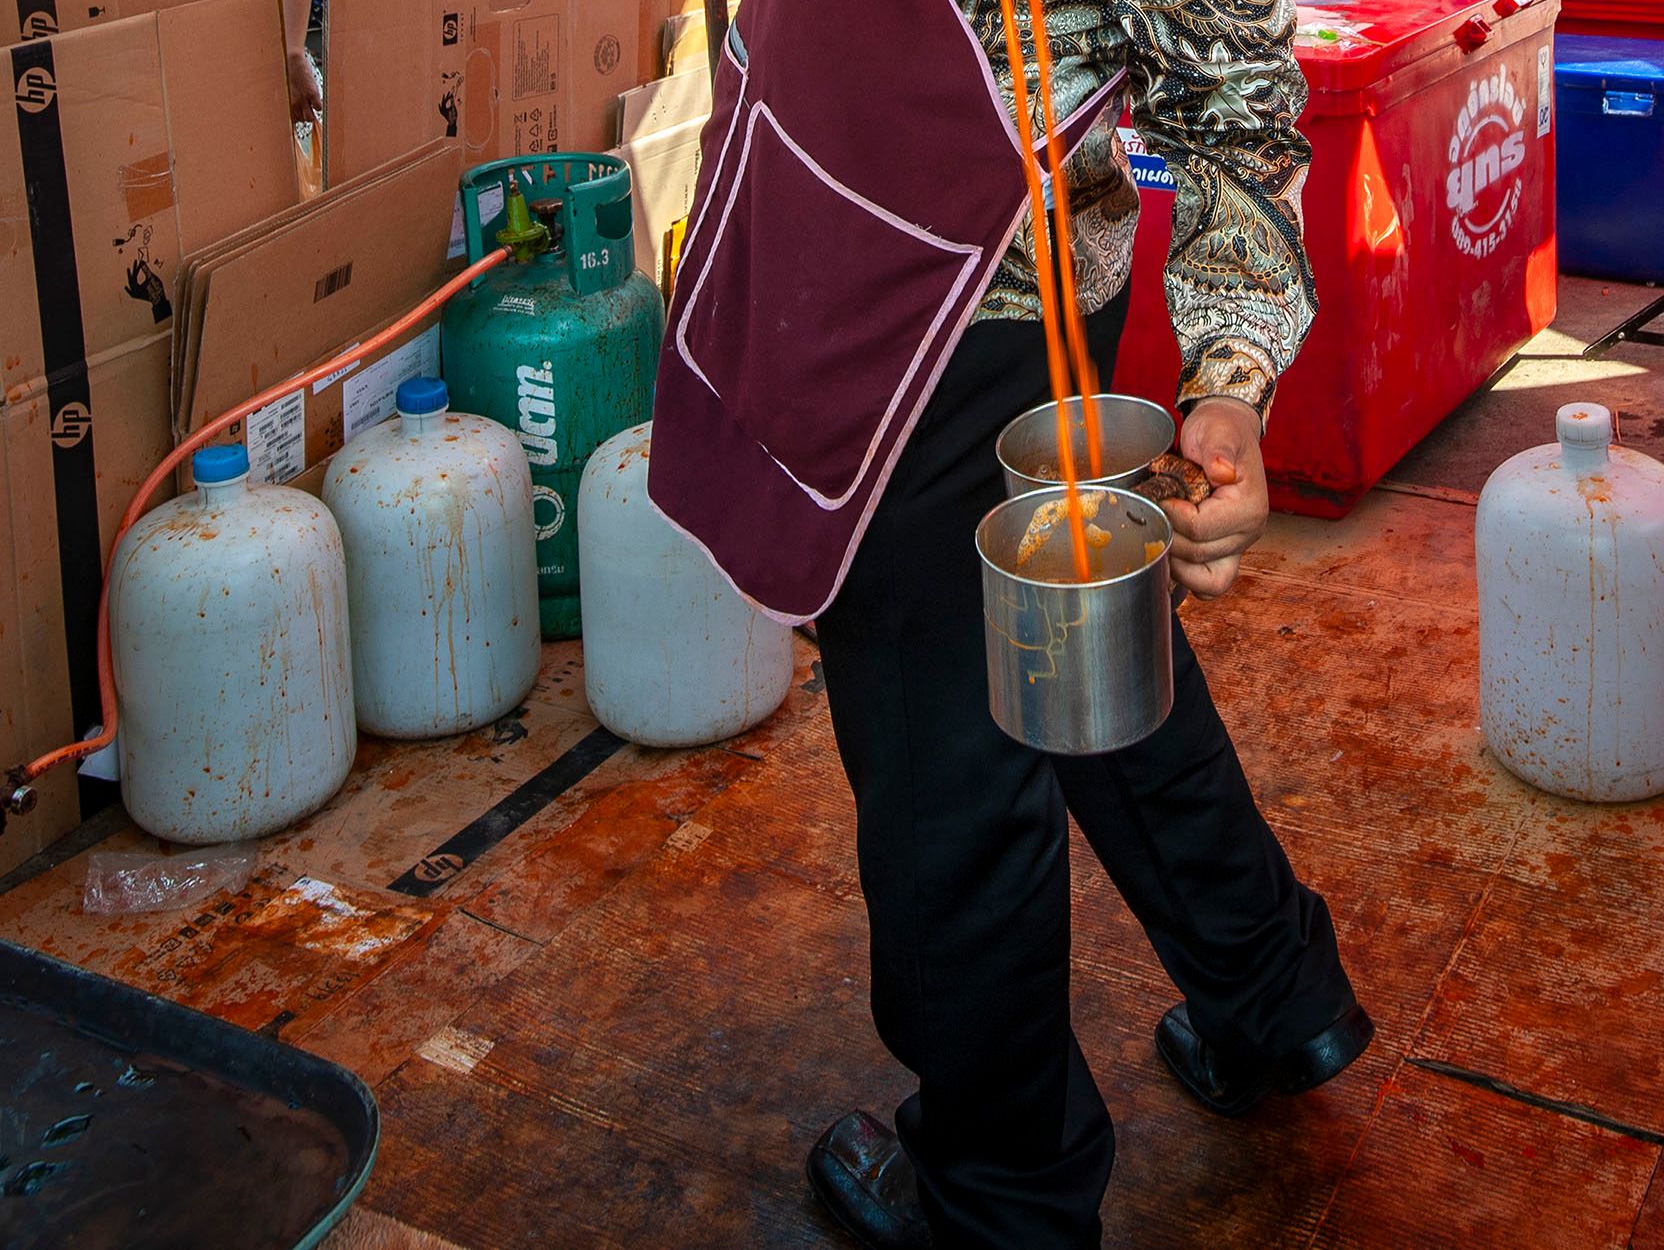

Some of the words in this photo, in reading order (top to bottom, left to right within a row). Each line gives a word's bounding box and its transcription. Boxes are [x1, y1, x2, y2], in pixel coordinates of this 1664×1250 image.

[15, 70, 58, 110] hp
[580, 249, 610, 270] 16.3
[51, 406, 92, 443] hp
